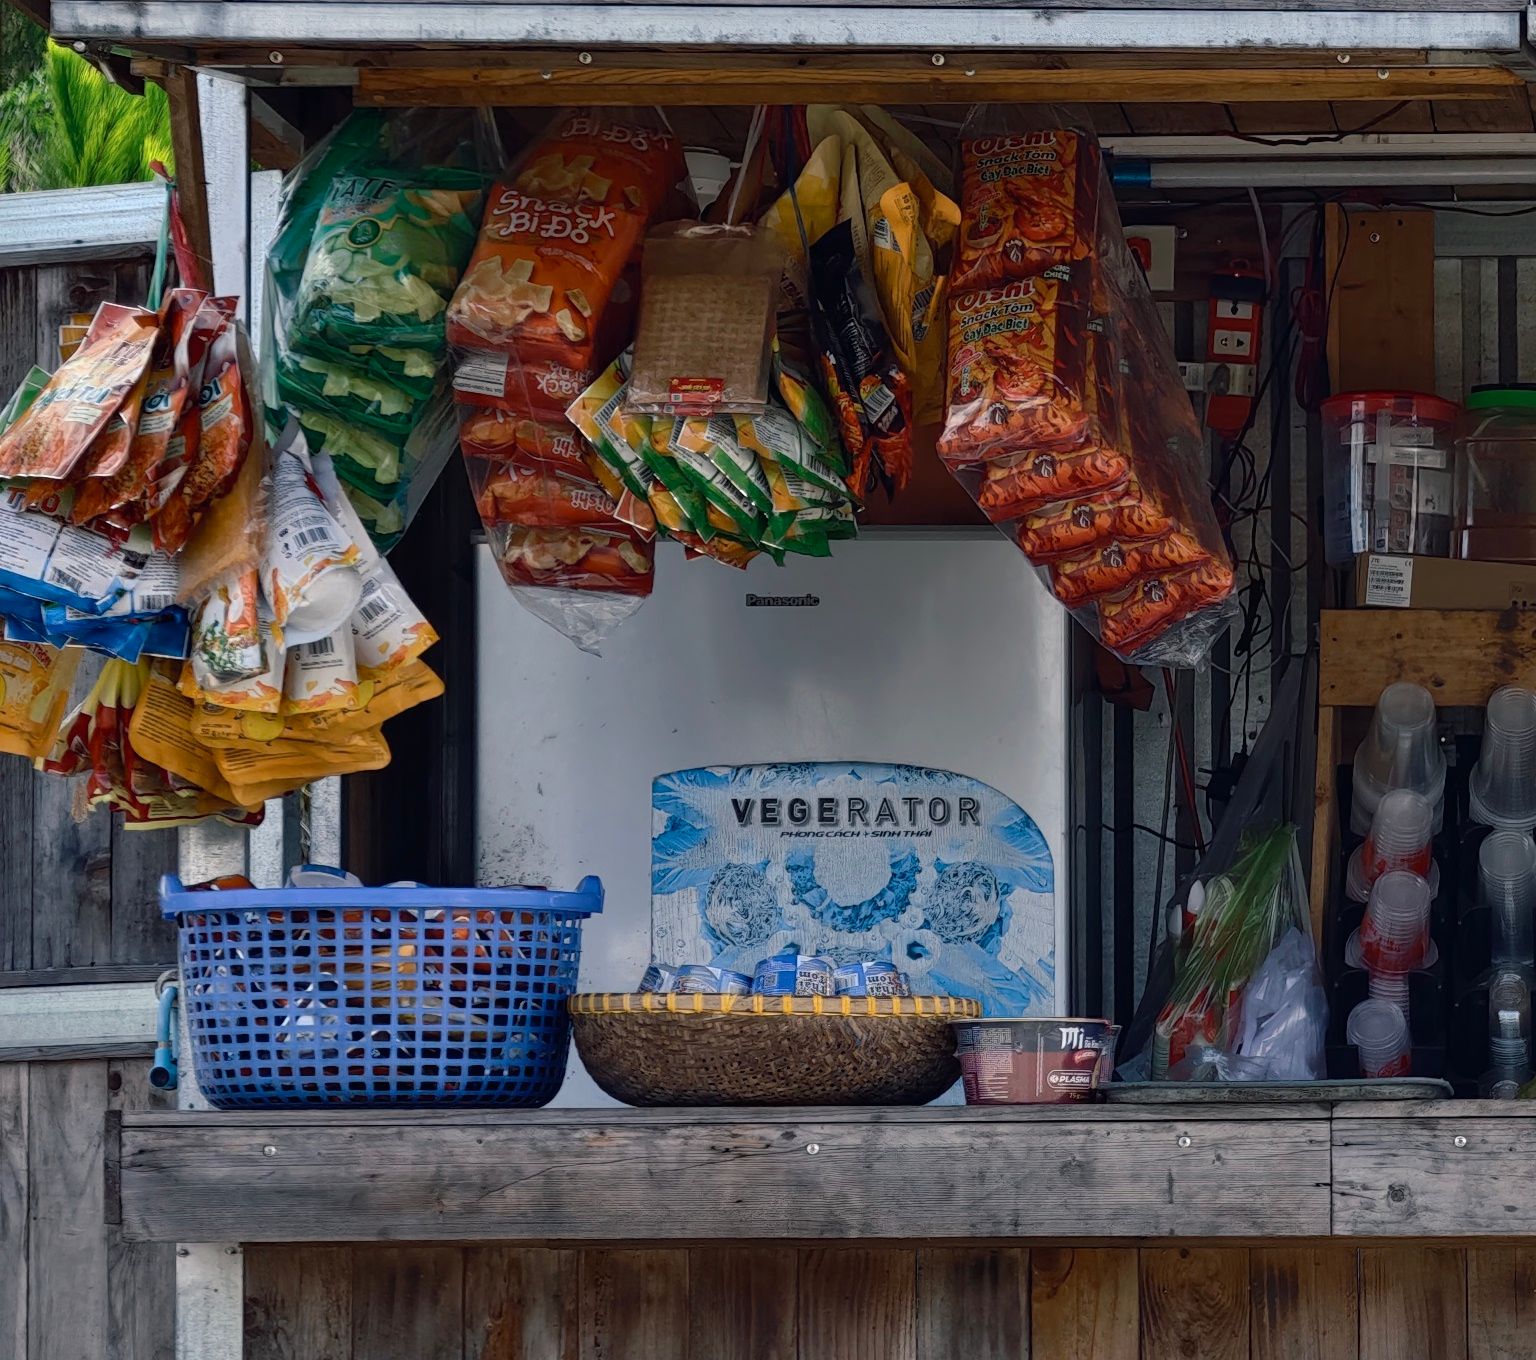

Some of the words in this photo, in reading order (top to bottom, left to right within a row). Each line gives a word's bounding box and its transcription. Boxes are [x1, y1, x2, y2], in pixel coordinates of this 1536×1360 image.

[976, 152, 1022, 169] Snack
[492, 190, 616, 238] Snack
[960, 307, 1000, 330] Snack
[746, 593, 820, 607] Panasonic
[731, 797, 978, 824] VEGERATOR
[870, 830, 901, 838] SINH
